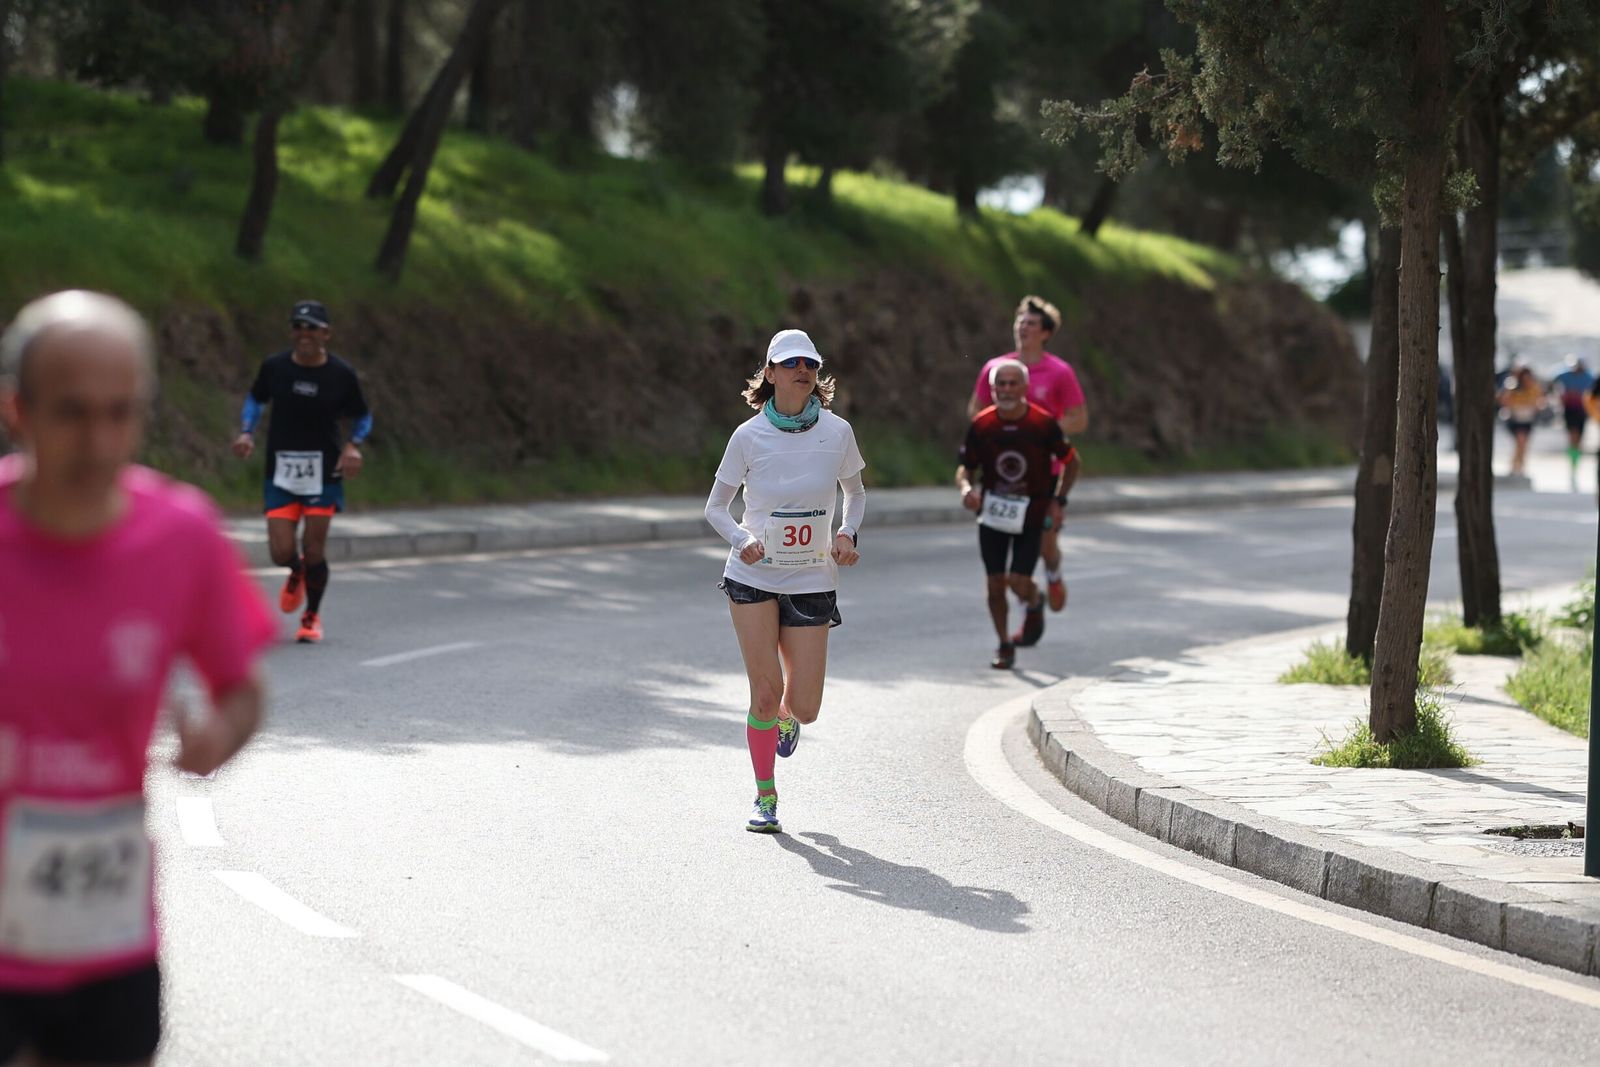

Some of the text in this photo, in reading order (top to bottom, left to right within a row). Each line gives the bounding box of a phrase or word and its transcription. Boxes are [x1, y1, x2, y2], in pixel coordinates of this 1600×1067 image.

[283, 463, 314, 479] 714
[990, 501, 1018, 520] 628
[783, 524, 812, 547] 30
